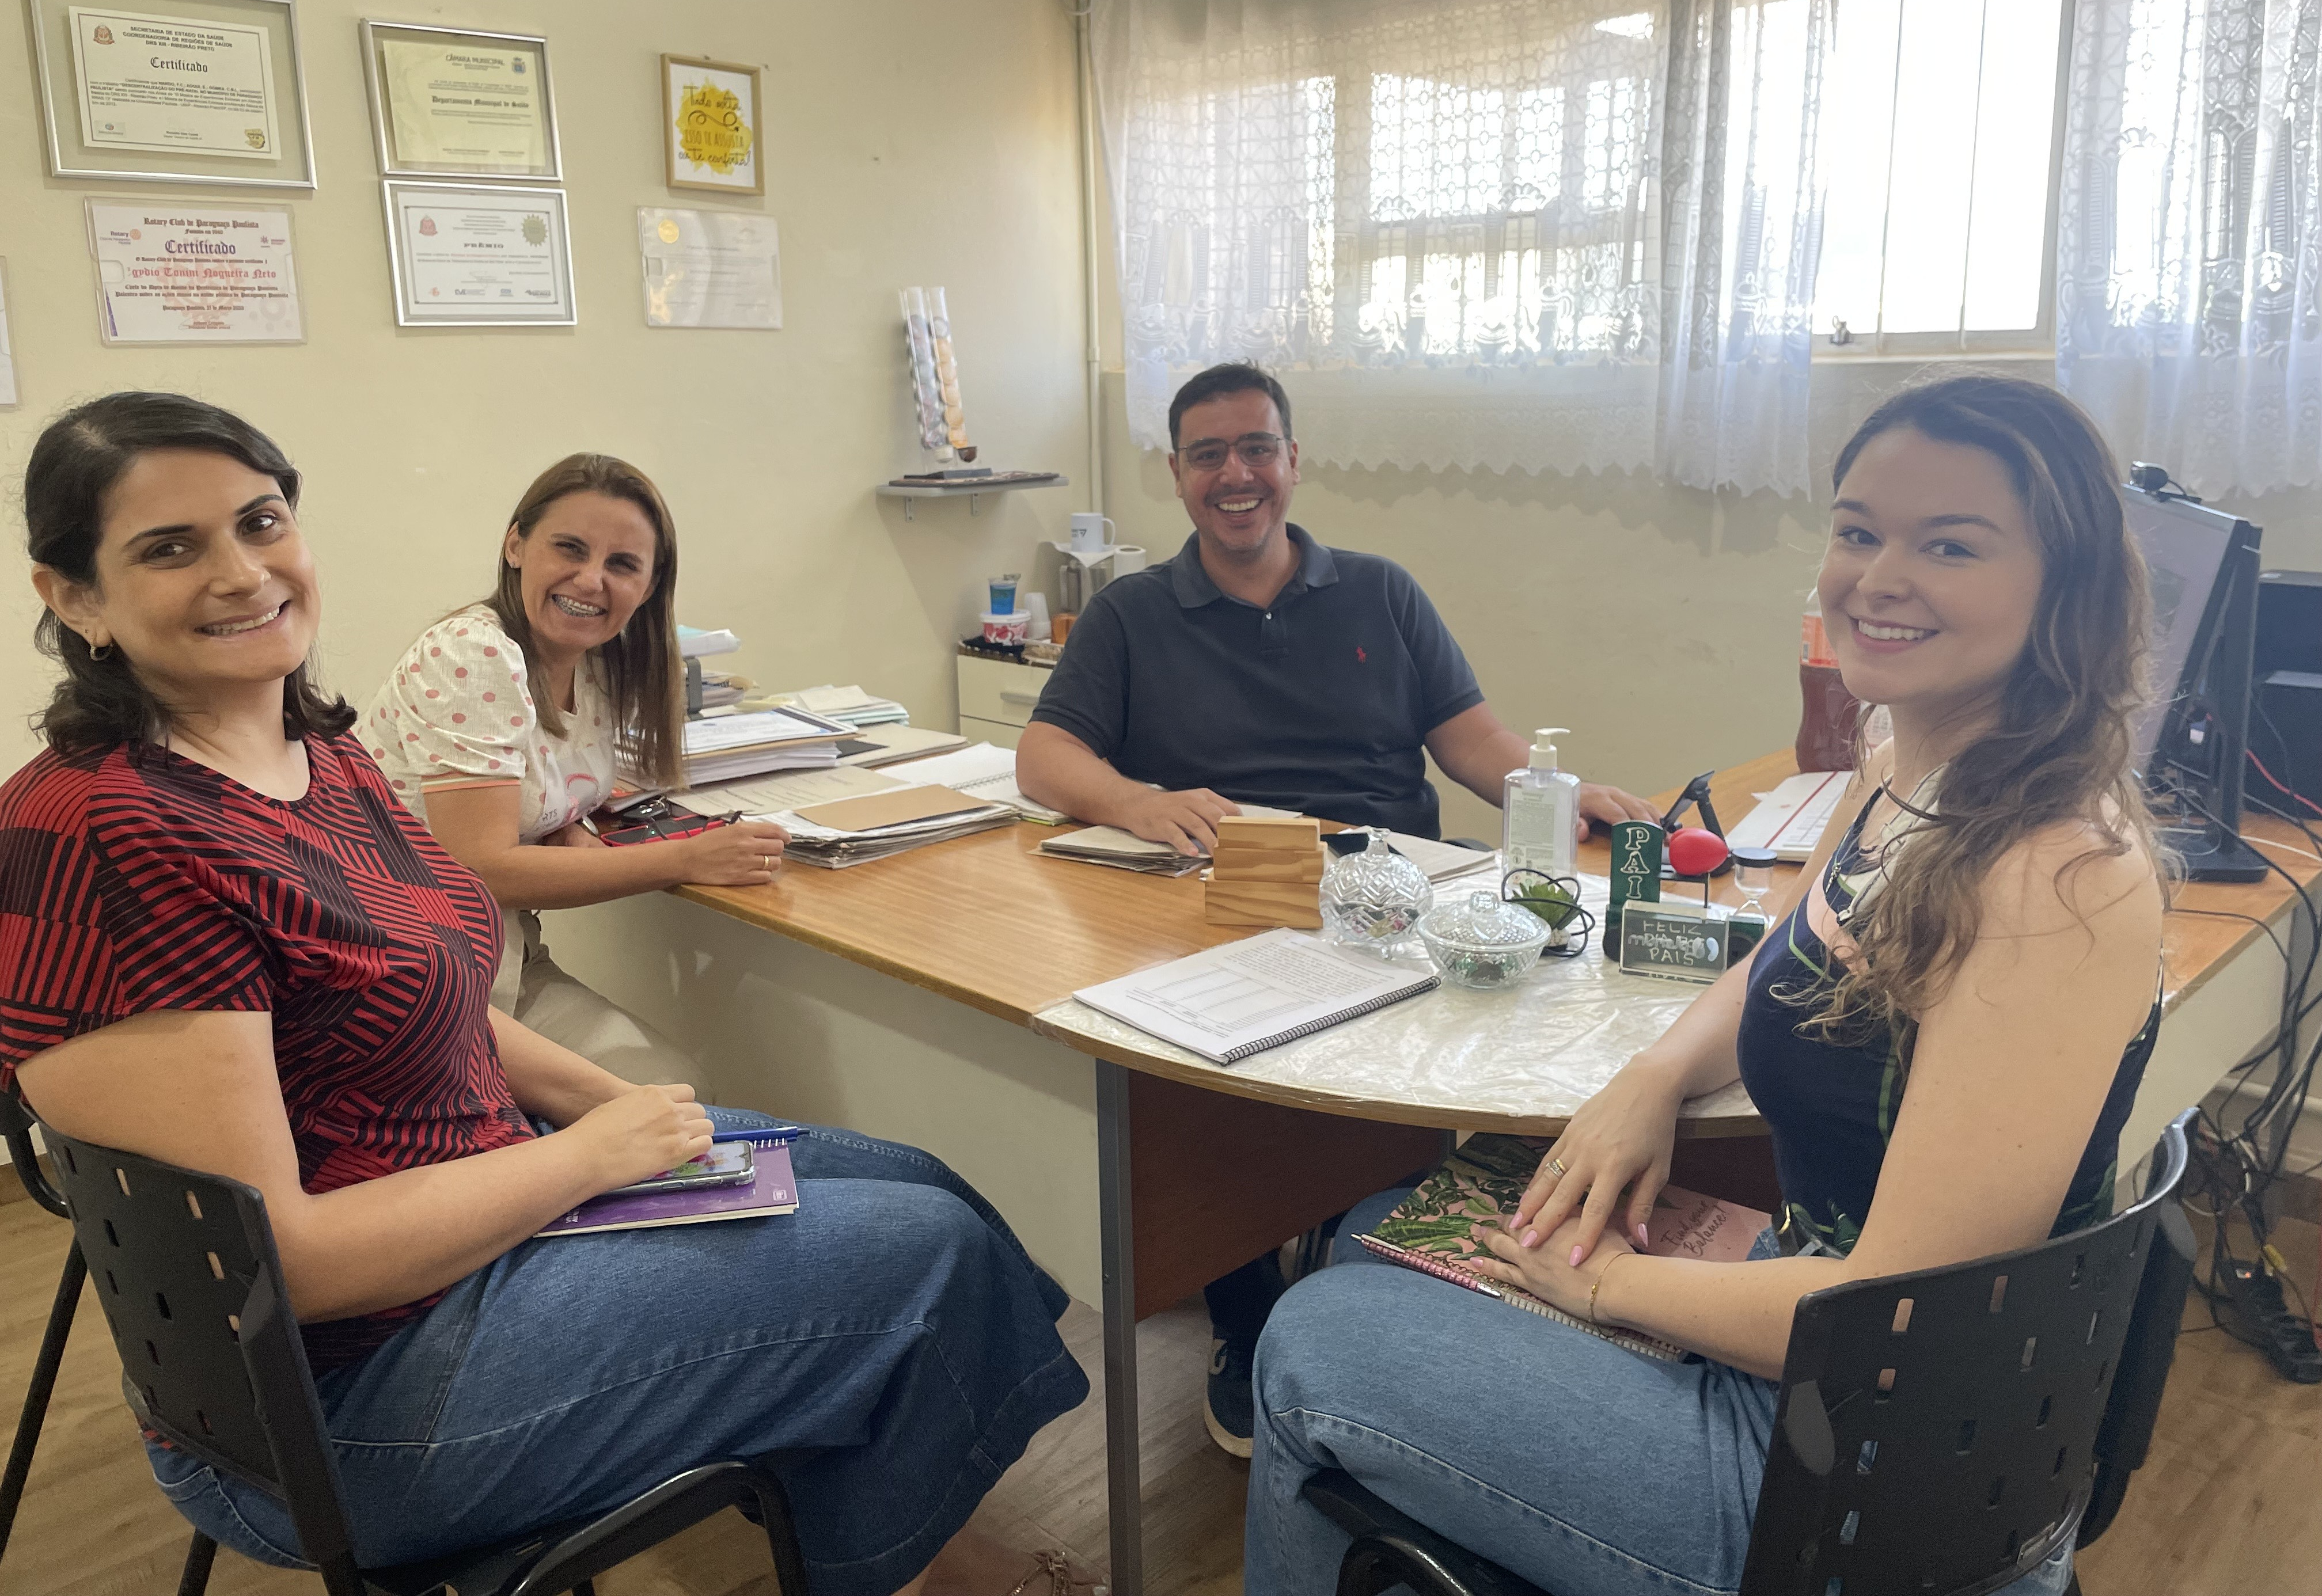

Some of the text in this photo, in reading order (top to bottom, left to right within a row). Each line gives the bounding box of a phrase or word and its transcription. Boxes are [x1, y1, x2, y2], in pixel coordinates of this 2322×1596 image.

[130, 26, 165, 35] SECRETARIA
[123, 32, 170, 41] COORDENADORIA
[181, 37, 204, 45] REGIÕES
[150, 56, 208, 73] Certificado
[143, 218, 167, 227] Rotary
[165, 240, 236, 255] Certificado
[203, 268, 249, 279] Nogueira
[252, 269, 276, 279] Neto
[1620, 826, 1650, 899] PAI
[1644, 920, 1701, 936] FELIZ
[1649, 947, 1694, 966] PAIS
[1660, 1220, 1693, 1246] Find
